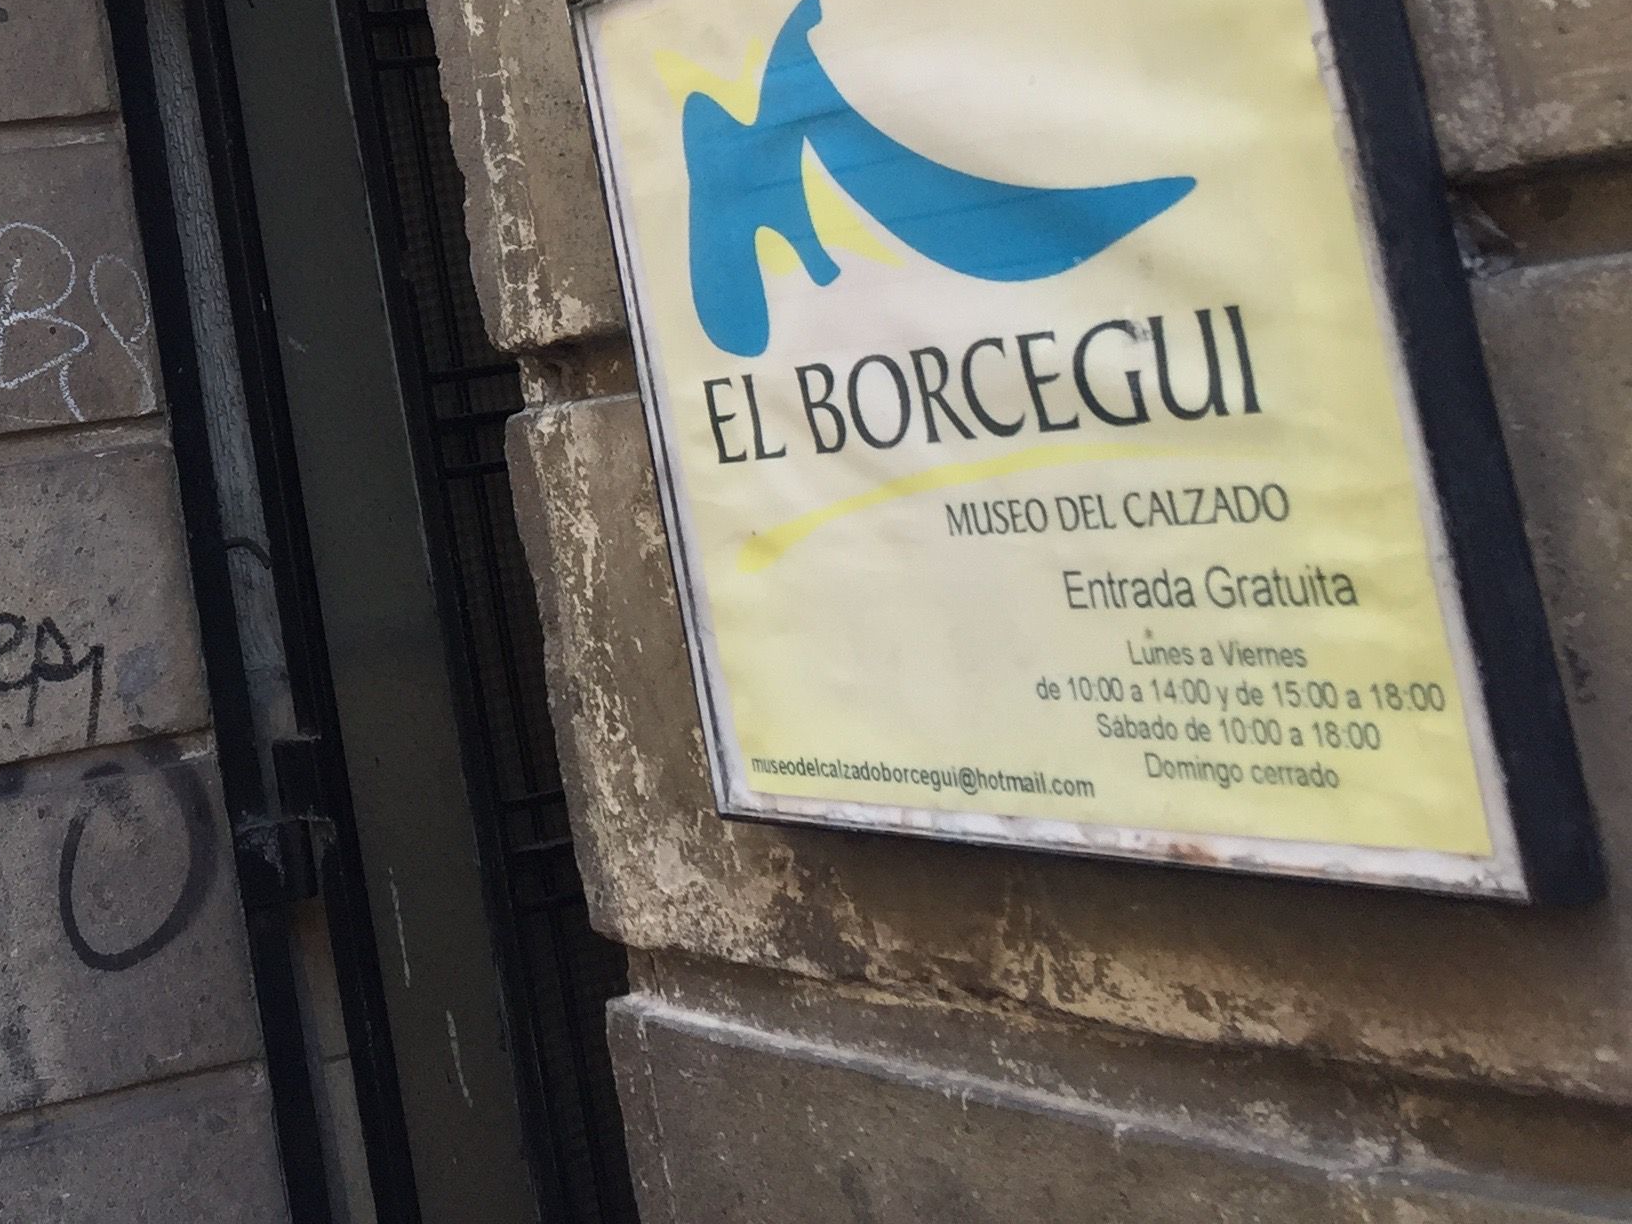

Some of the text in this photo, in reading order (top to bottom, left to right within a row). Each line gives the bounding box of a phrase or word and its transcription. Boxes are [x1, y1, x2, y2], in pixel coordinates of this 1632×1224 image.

[703, 304, 1262, 464] EL BORCEGUI
[946, 483, 1290, 536] MUSEO DEL CALZADO
[1062, 564, 1359, 610] Entrada Gratuita
[1127, 639, 1308, 669] Lunes a Viernes
[1036, 677, 1446, 712] de 10:00 a 14:00 y de 15:00 a 18:00
[1097, 713, 1382, 751] Sábado de 10:00 a 18:00
[751, 755, 1096, 799] museodelcalzadoborcegui@hotmail.com
[1144, 752, 1340, 790] Domingo cerrado
